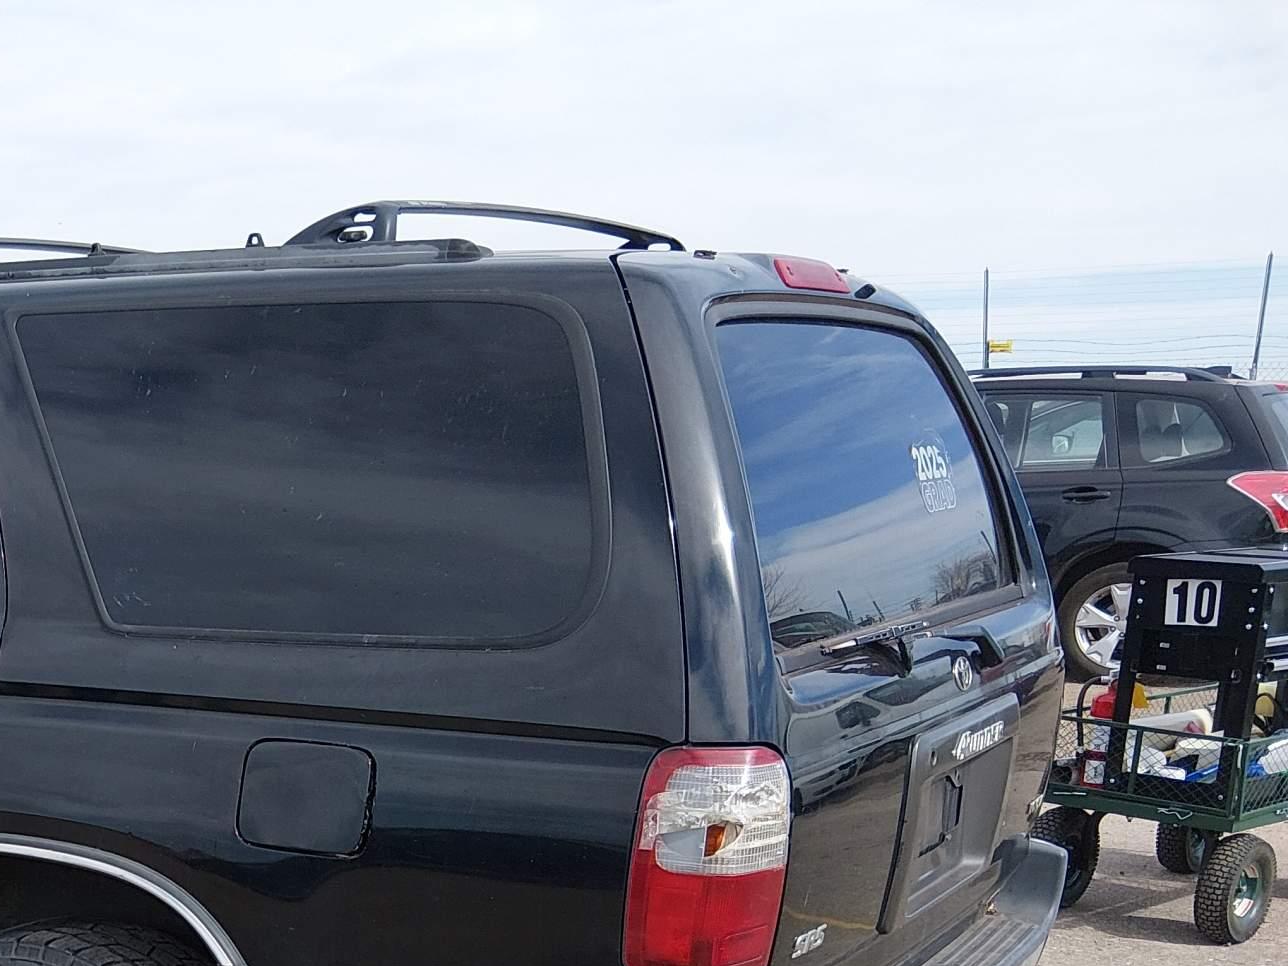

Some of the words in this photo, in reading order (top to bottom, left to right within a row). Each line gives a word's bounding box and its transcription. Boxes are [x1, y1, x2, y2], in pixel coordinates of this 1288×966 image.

[912, 445, 947, 480] 2025
[921, 479, 957, 513] GRAD
[1172, 580, 1218, 625] 10
[792, 923, 828, 959] SR5
